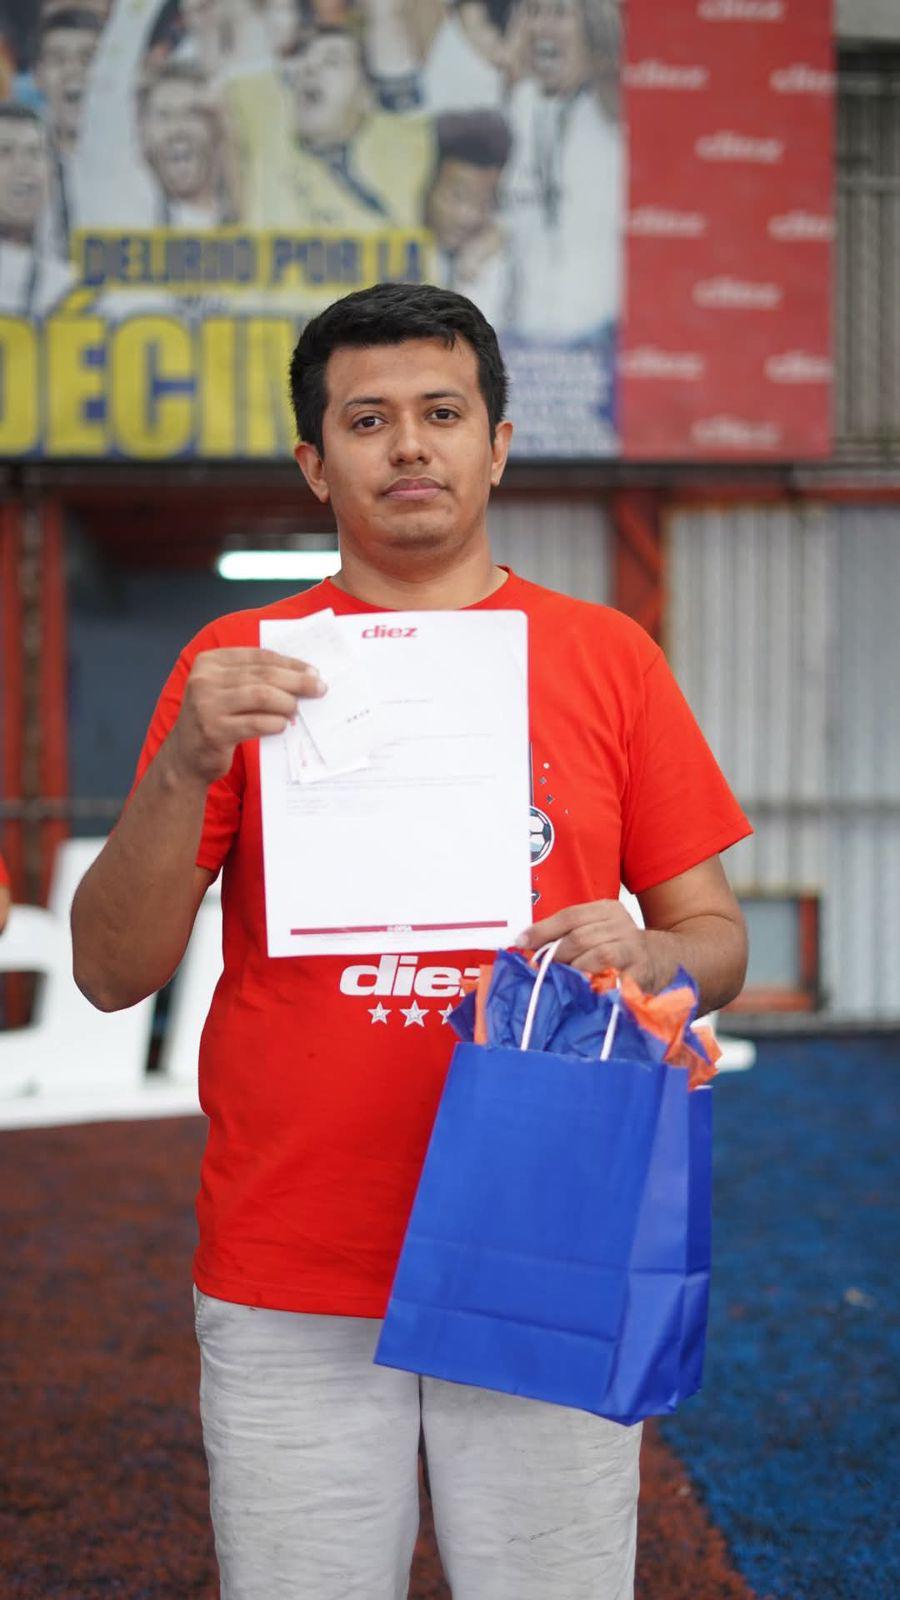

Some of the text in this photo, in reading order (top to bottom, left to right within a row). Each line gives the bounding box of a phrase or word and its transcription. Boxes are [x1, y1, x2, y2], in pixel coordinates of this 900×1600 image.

[274, 236, 361, 286] POR
[376, 236, 425, 286] LA
[361, 624, 419, 639] diez
